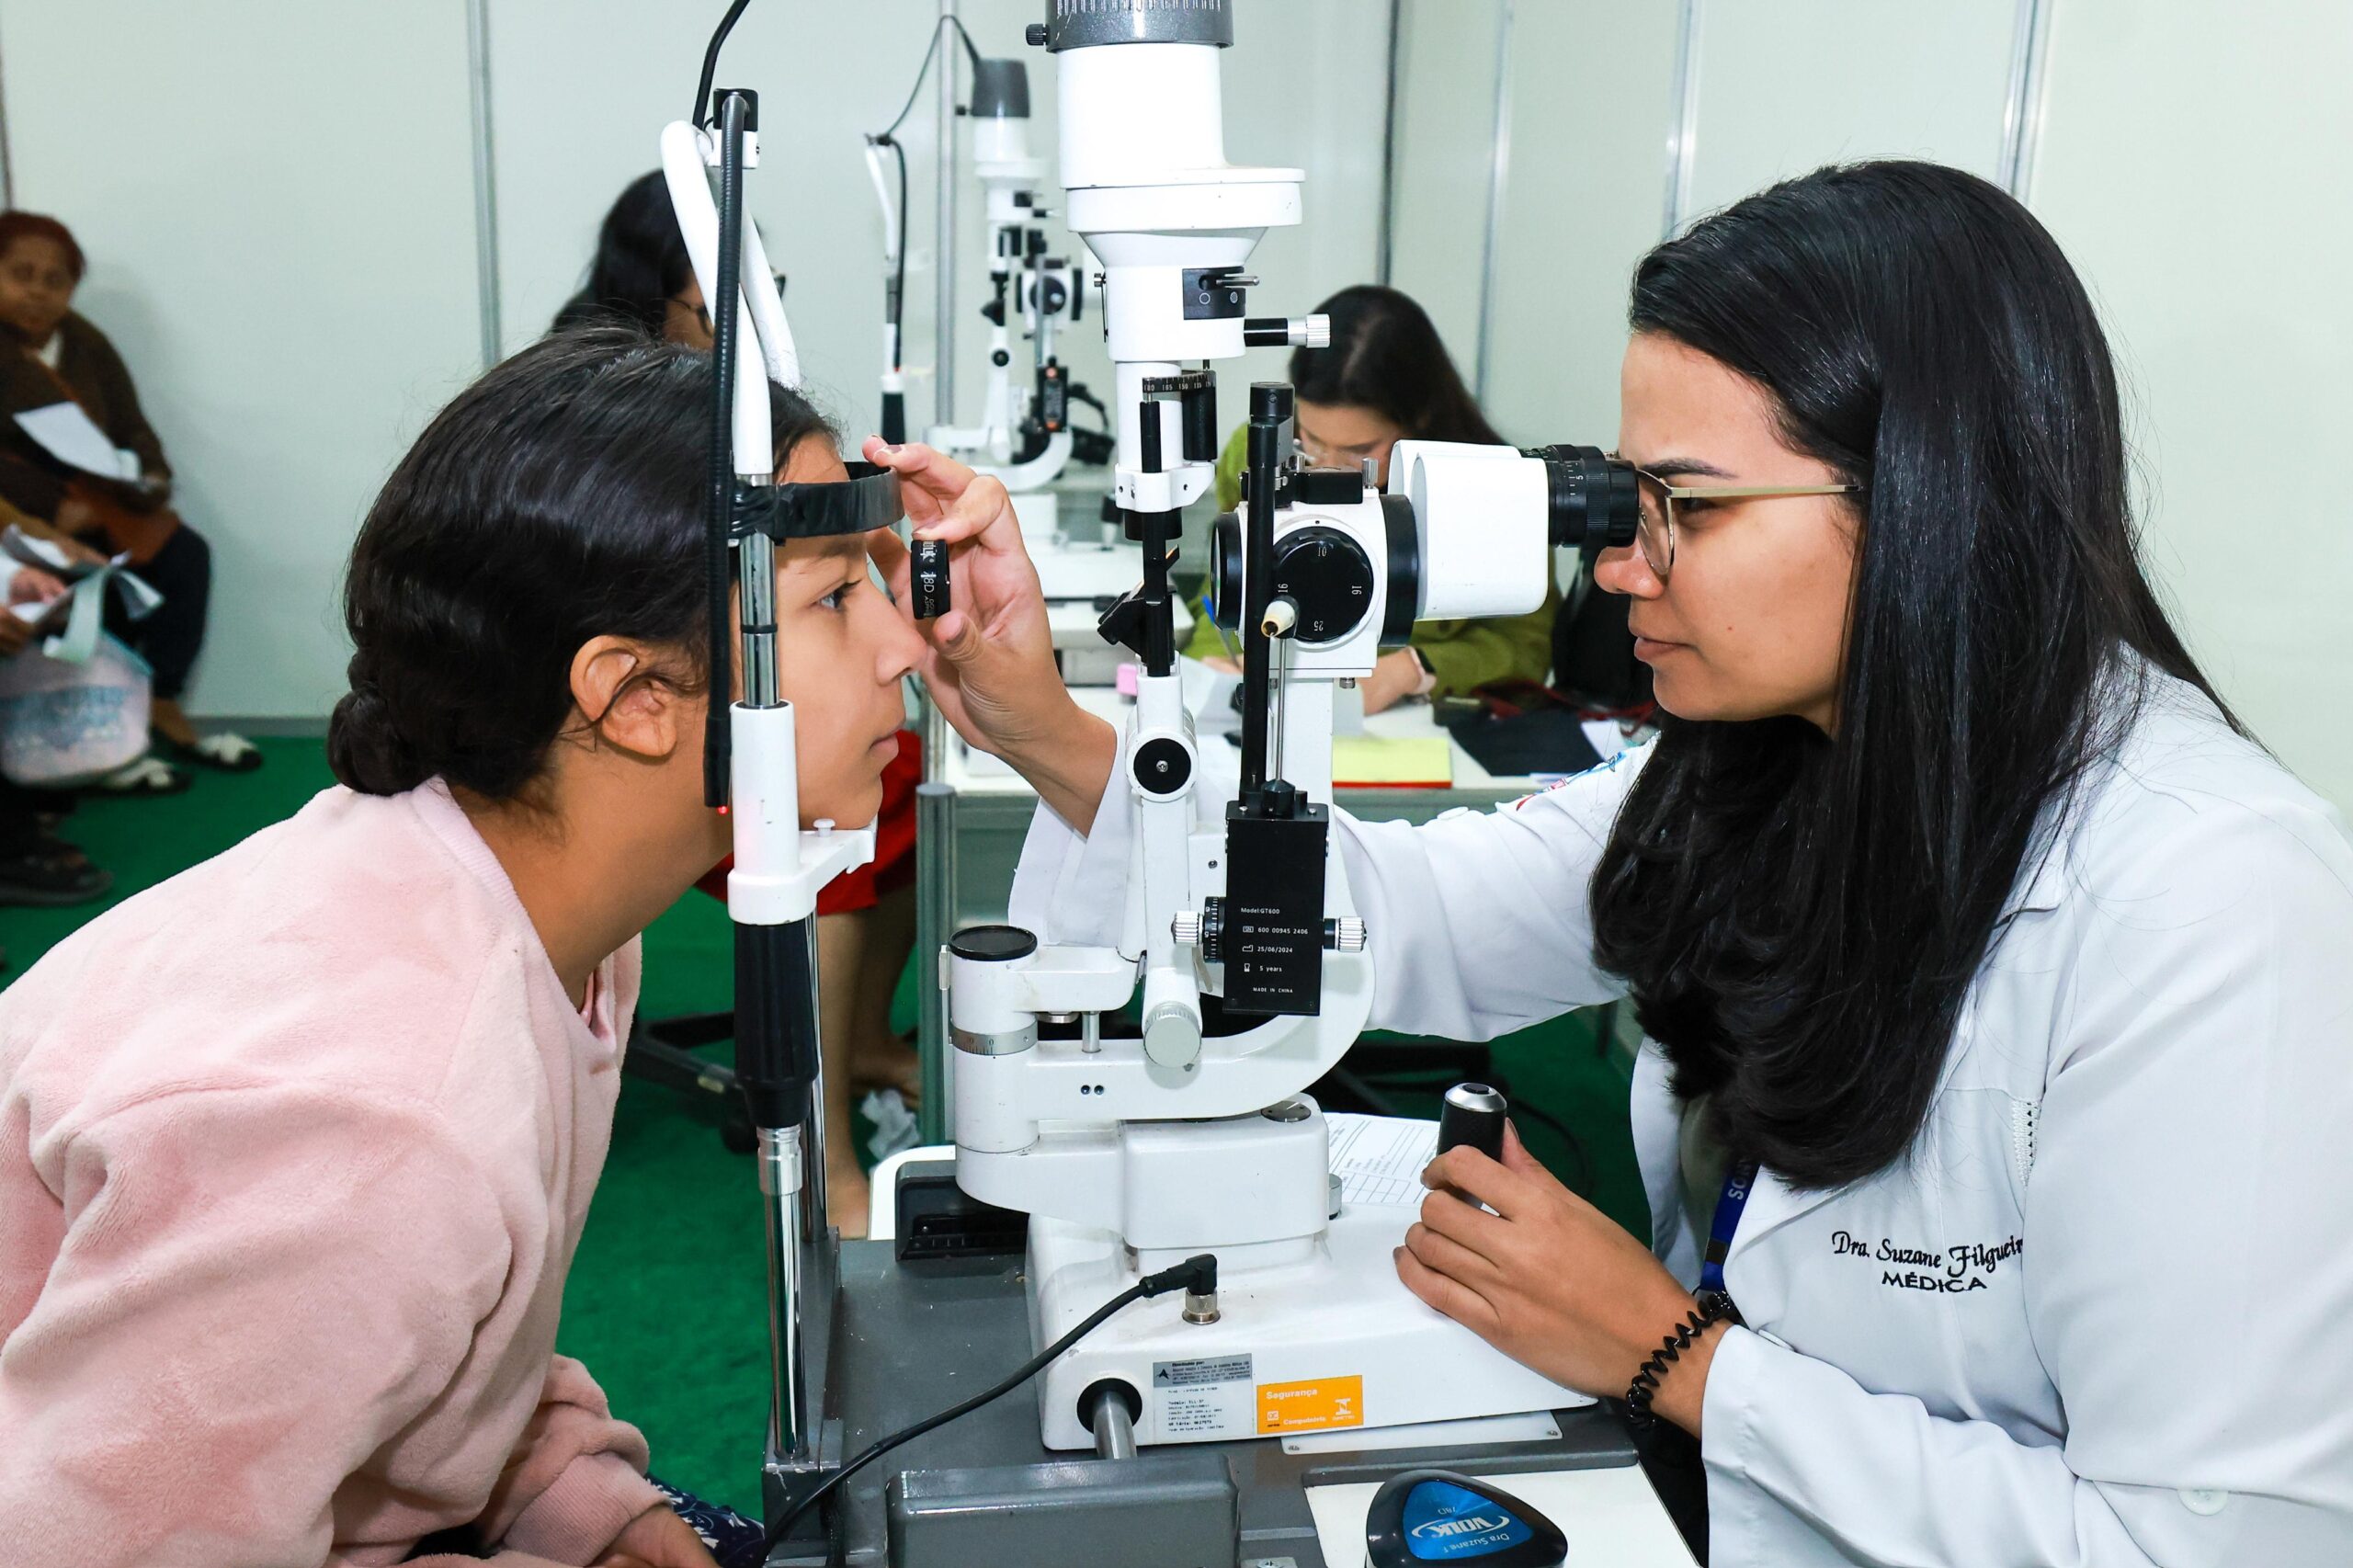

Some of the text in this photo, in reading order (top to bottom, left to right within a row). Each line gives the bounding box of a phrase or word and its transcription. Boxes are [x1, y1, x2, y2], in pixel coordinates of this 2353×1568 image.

[1317, 546, 1327, 557] 10
[1278, 583, 1289, 593] 16
[1351, 585, 1362, 595] 16
[1313, 620, 1324, 631] 25
[1831, 1231, 2024, 1278] Dra. Suzane Filgueir
[1881, 1270, 1988, 1293] MÉDICA
[1266, 1388, 1318, 1400] Segurança
[1427, 1517, 1495, 1539] VOLK
[1490, 1533, 1510, 1542] Dra
[1452, 1537, 1489, 1551] Suzane
